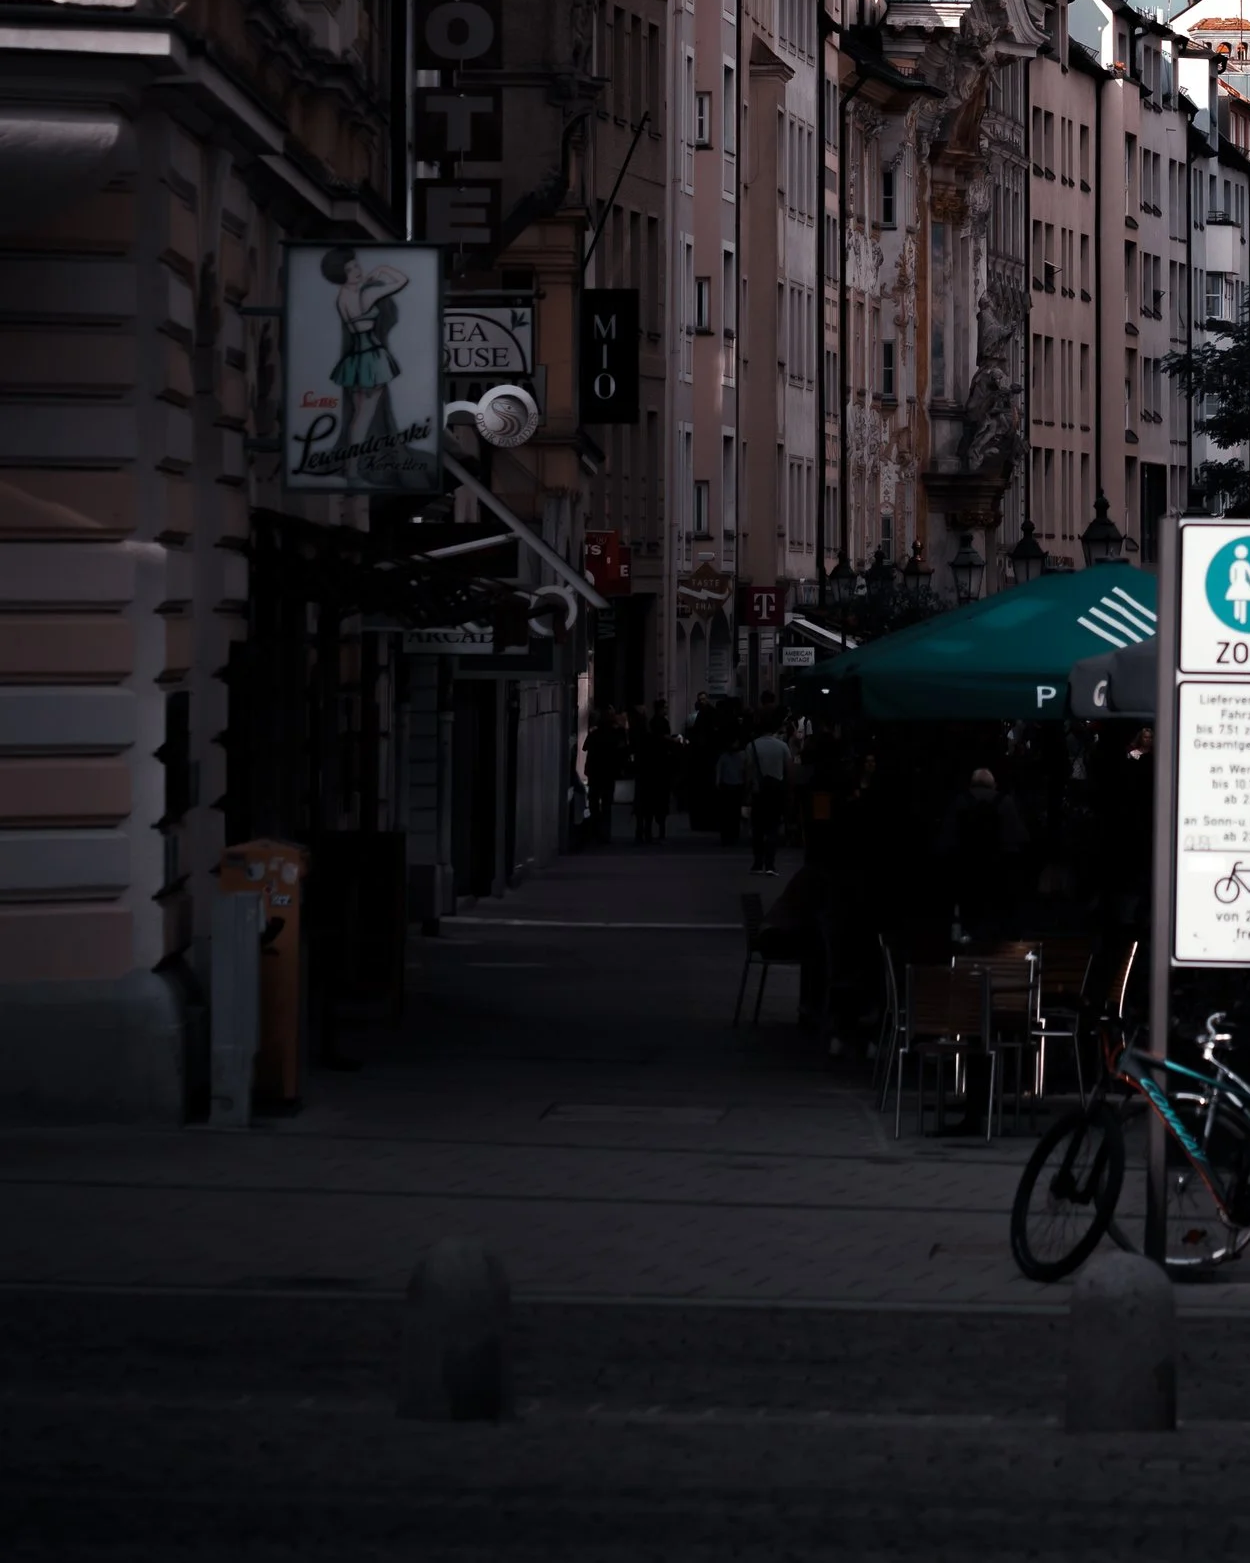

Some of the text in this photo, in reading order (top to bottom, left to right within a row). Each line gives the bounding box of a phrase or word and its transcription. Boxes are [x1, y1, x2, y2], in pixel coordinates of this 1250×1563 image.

[444, 322, 489, 342] EA
[443, 347, 510, 369] USE
[592, 313, 617, 400] MIO
[291, 412, 432, 476] Lewandowski
[408, 632, 495, 644] ARCAD
[1196, 724, 1213, 734] bis
[1209, 766, 1223, 774] an
[1212, 780, 1229, 790] bis
[1224, 794, 1237, 805] ab
[1184, 816, 1197, 825] an
[1223, 831, 1236, 842] ab
[1215, 912, 1239, 922] von
